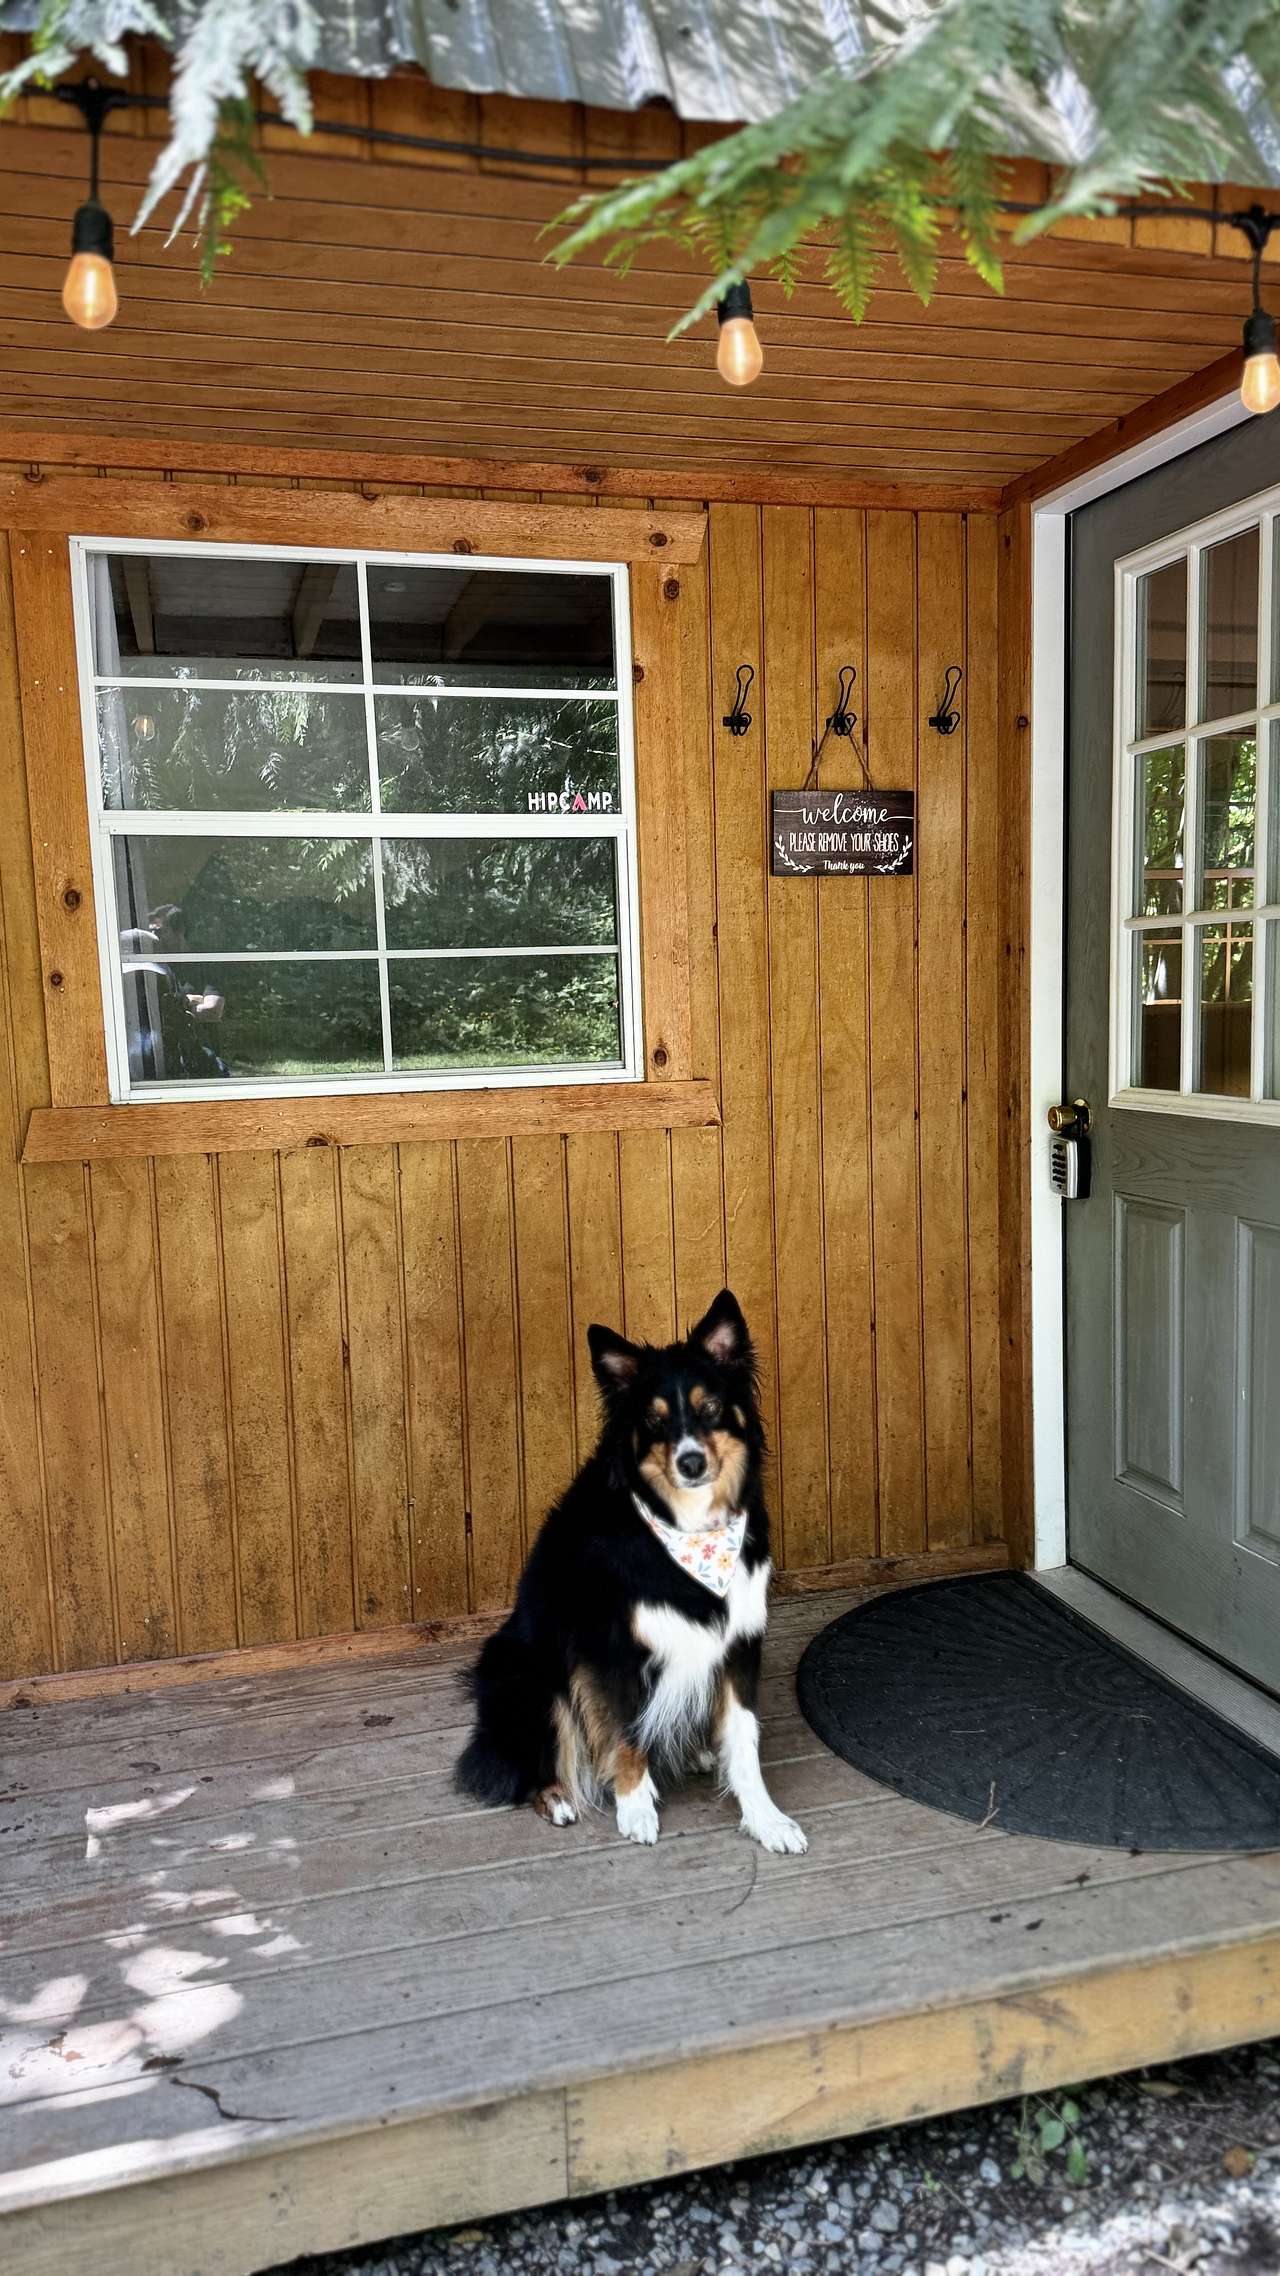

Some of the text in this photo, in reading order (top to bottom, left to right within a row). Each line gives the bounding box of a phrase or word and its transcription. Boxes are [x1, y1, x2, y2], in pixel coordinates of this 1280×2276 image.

[527, 791, 613, 811] HIPCAMP
[799, 792, 893, 825] welcome
[789, 832, 900, 852] PLEASE REMOVE YOUR SHOES
[823, 860, 865, 874] Thank you
